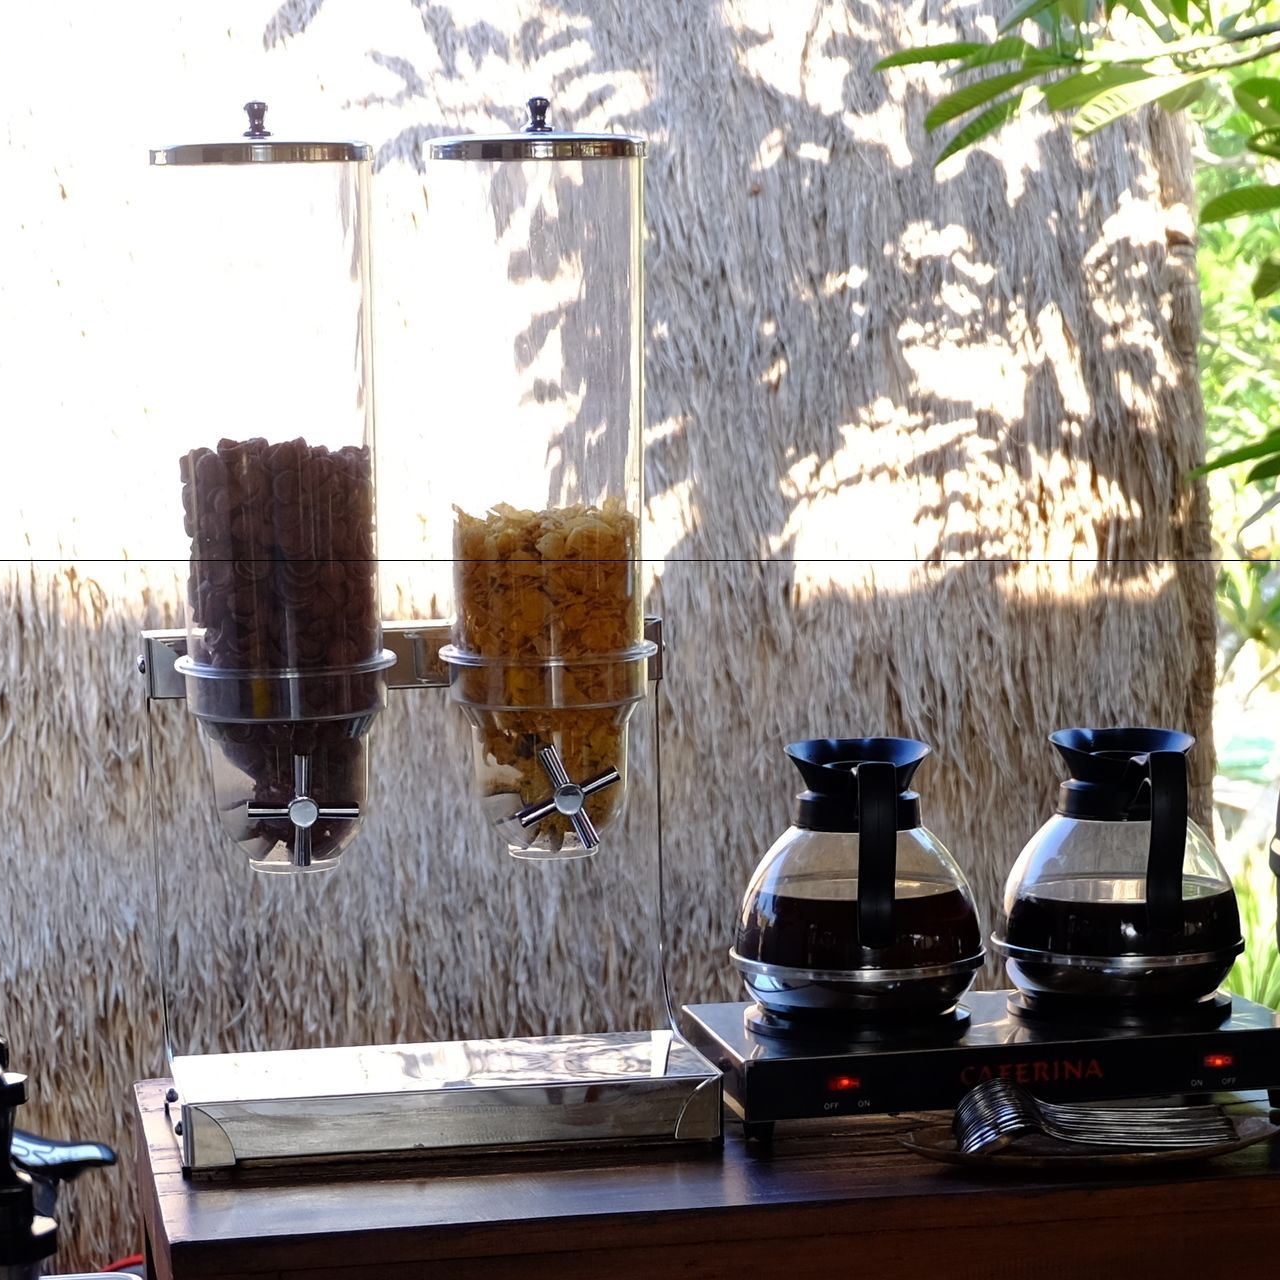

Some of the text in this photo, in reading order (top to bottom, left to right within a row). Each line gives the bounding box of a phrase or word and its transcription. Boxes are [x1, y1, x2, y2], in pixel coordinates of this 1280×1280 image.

[960, 1059, 1105, 1086] CAFERINA
[1190, 1077, 1236, 1087] ON OFF
[823, 1099, 870, 1110] OFF ON
